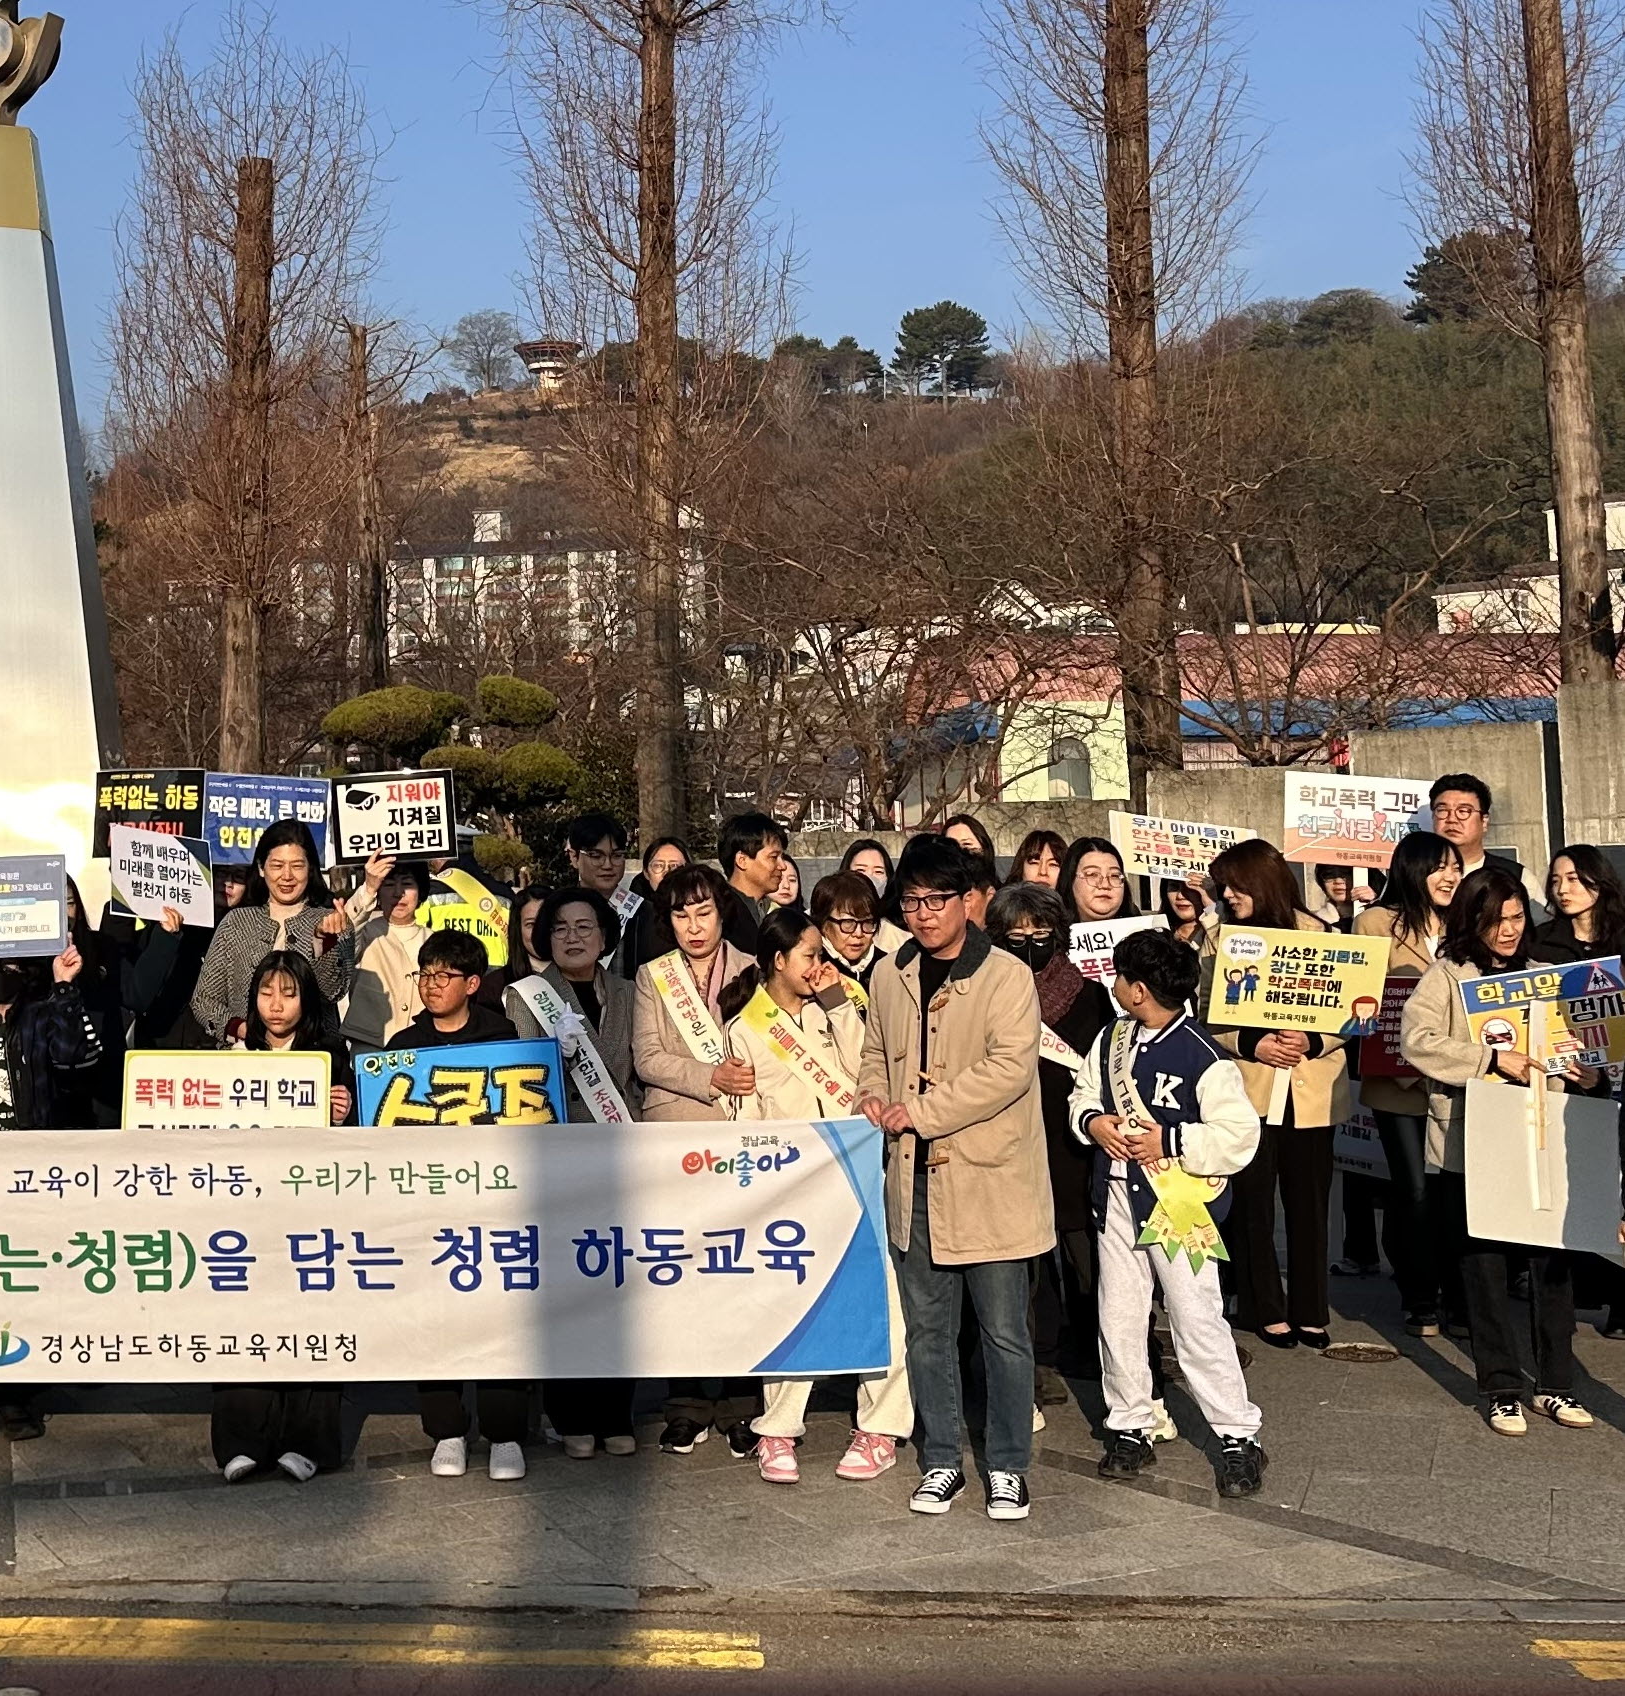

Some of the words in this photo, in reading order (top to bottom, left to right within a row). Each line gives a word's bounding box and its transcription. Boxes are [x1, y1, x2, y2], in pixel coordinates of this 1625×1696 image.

[99, 785, 160, 811] 폭력없는
[165, 784, 199, 811] 하동
[386, 781, 441, 803] 지워야
[1299, 785, 1376, 811] 학교폭력
[1382, 791, 1421, 815] 그만
[208, 795, 238, 818] 작은
[278, 799, 294, 821] 큰
[296, 800, 326, 823] 변화
[388, 805, 442, 827] 지켜질
[1132, 817, 1163, 831] 우리
[131, 840, 154, 859] 함께
[156, 845, 191, 866] 배우며
[349, 832, 400, 854] 우리의
[408, 829, 443, 850] 권리
[120, 859, 155, 879] 미래를
[157, 864, 204, 886] 열어가는
[1133, 852, 1206, 871] 지켜주세
[131, 880, 166, 901] 별천지
[169, 885, 193, 904] 하동
[1271, 945, 1318, 961] 사소한
[1270, 960, 1301, 975] 장난
[1304, 963, 1336, 978] 또한
[1268, 975, 1343, 994] 학교폭력에
[1475, 973, 1562, 1005] 학교앞
[1265, 989, 1344, 1009] 해당됩니다.
[363, 1051, 417, 1076] 안전한
[135, 1078, 175, 1107] 폭력
[182, 1078, 222, 1107] 없는
[229, 1078, 268, 1107] 우리
[277, 1078, 317, 1107] 학교
[1151, 1072, 1184, 1110] K
[741, 1135, 780, 1148] 경남교육
[6, 1164, 100, 1198] 교육이
[113, 1163, 177, 1198] 강한
[188, 1162, 263, 1199] 하동,
[280, 1161, 377, 1196] 우리가
[389, 1160, 518, 1196] 만들어요
[286, 1228, 404, 1293] 담는
[430, 1224, 542, 1292] 청렴
[574, 1218, 816, 1289] 하동교육
[41, 1331, 359, 1363] 경상남도하동교육지원청
